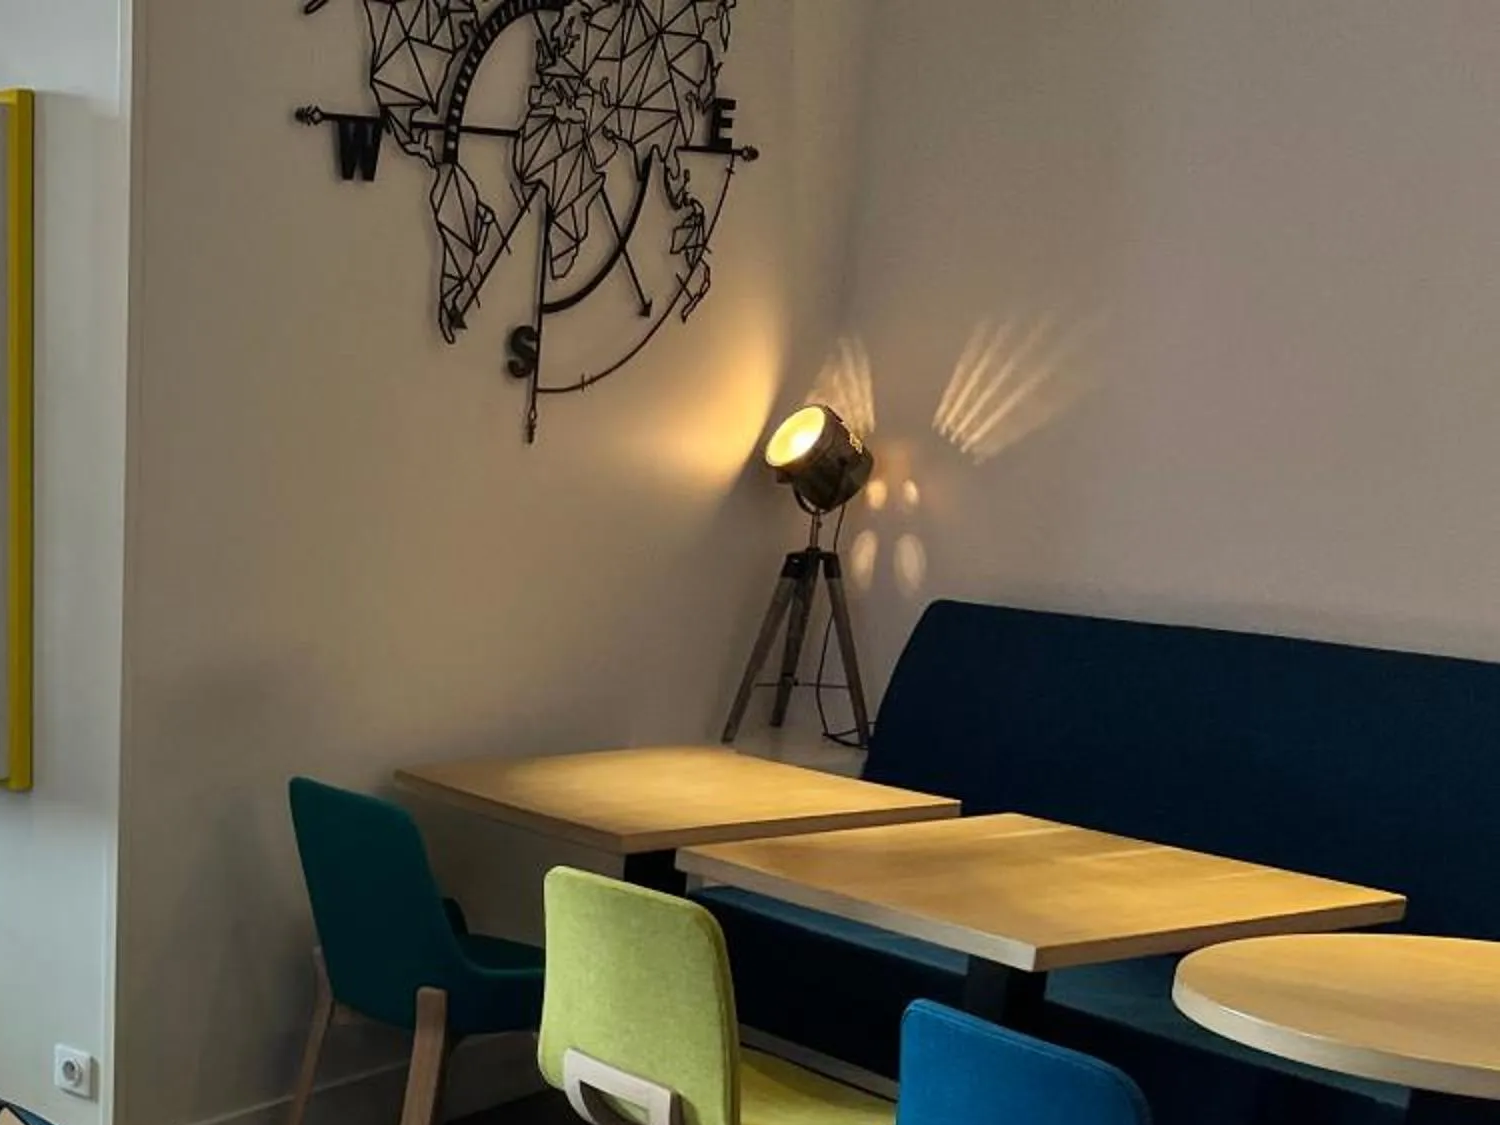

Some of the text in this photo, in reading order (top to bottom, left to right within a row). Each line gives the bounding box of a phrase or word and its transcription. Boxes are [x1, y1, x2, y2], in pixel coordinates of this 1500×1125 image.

[338, 118, 383, 181] W
[709, 98, 737, 151] E
[508, 325, 538, 379] S
